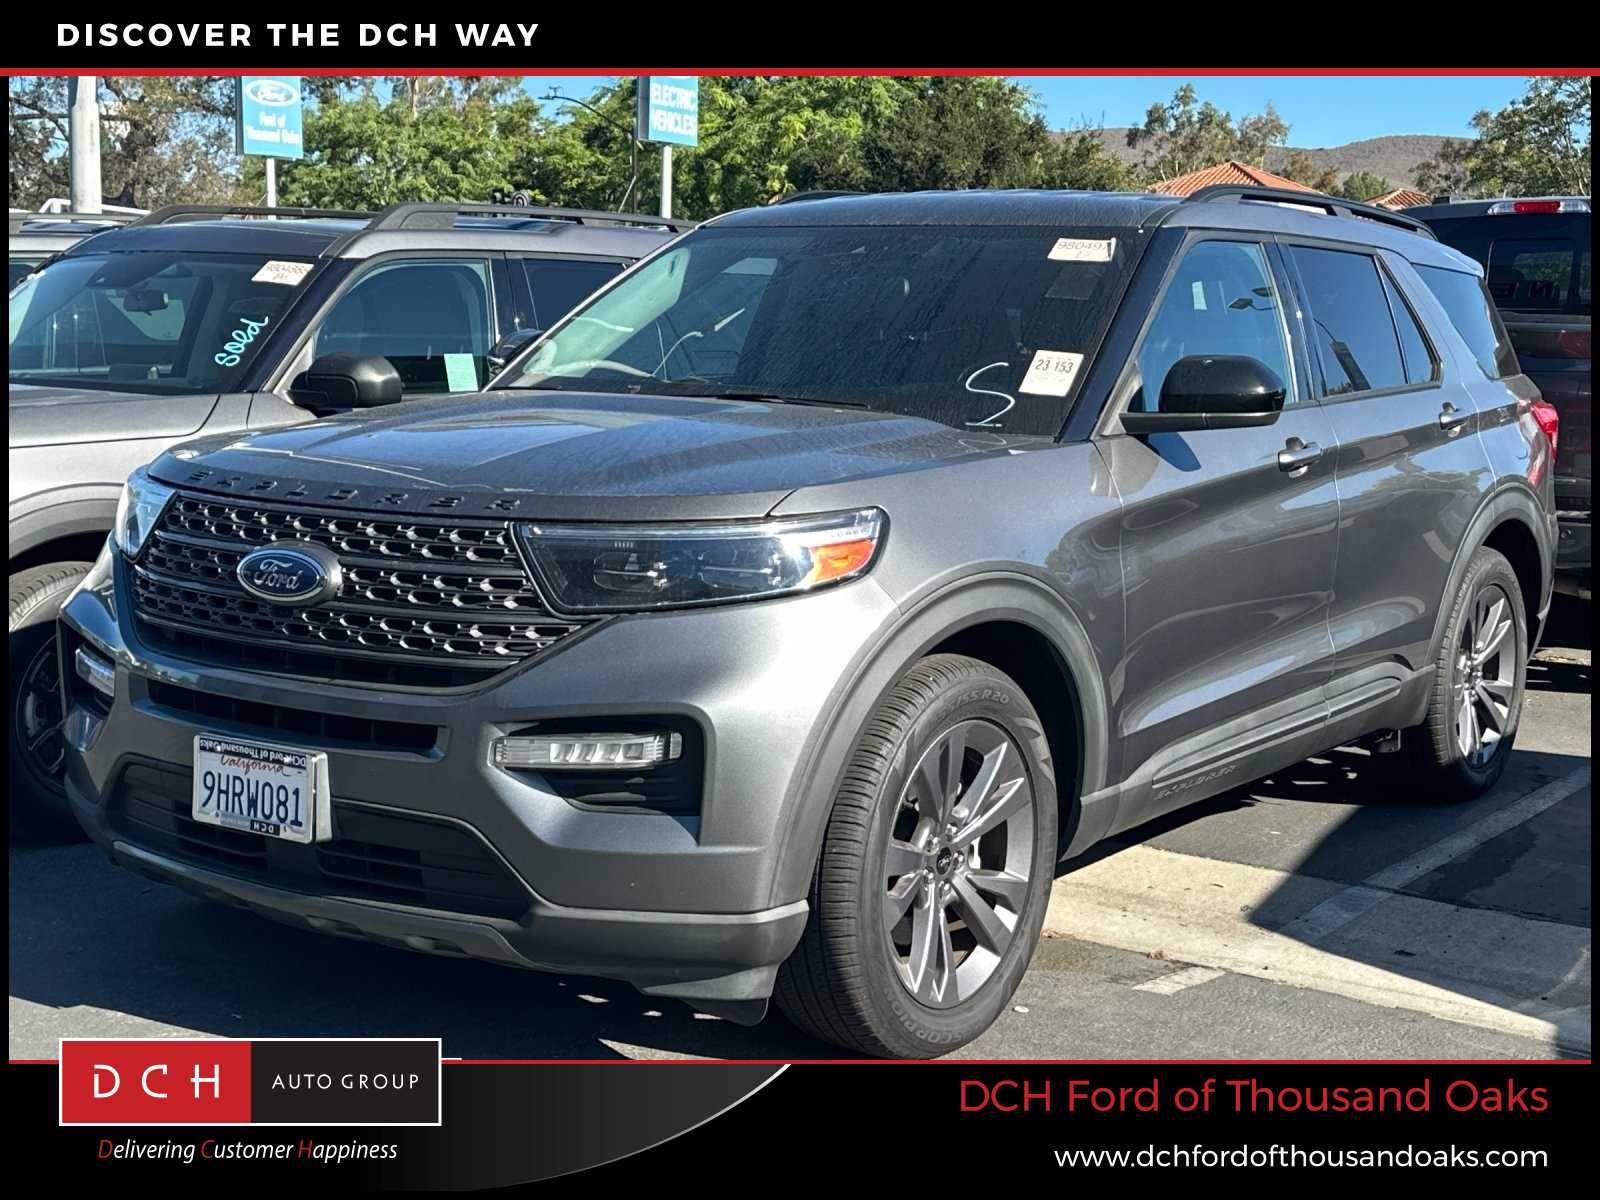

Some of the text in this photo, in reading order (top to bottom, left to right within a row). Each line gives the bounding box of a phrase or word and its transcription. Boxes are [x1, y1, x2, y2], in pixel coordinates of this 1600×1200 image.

[651, 83, 697, 111] ELECTRIC
[651, 109, 697, 136] VEHICLES
[214, 315, 269, 367] Sold
[1034, 358, 1052, 372] 23
[1053, 360, 1074, 374] 153
[965, 361, 1016, 427] S
[188, 470, 521, 511] EXPLORER
[253, 558, 304, 590] Ford
[220, 743, 260, 759] Thousand
[220, 754, 293, 776] California
[201, 770, 303, 828] 9HRW081
